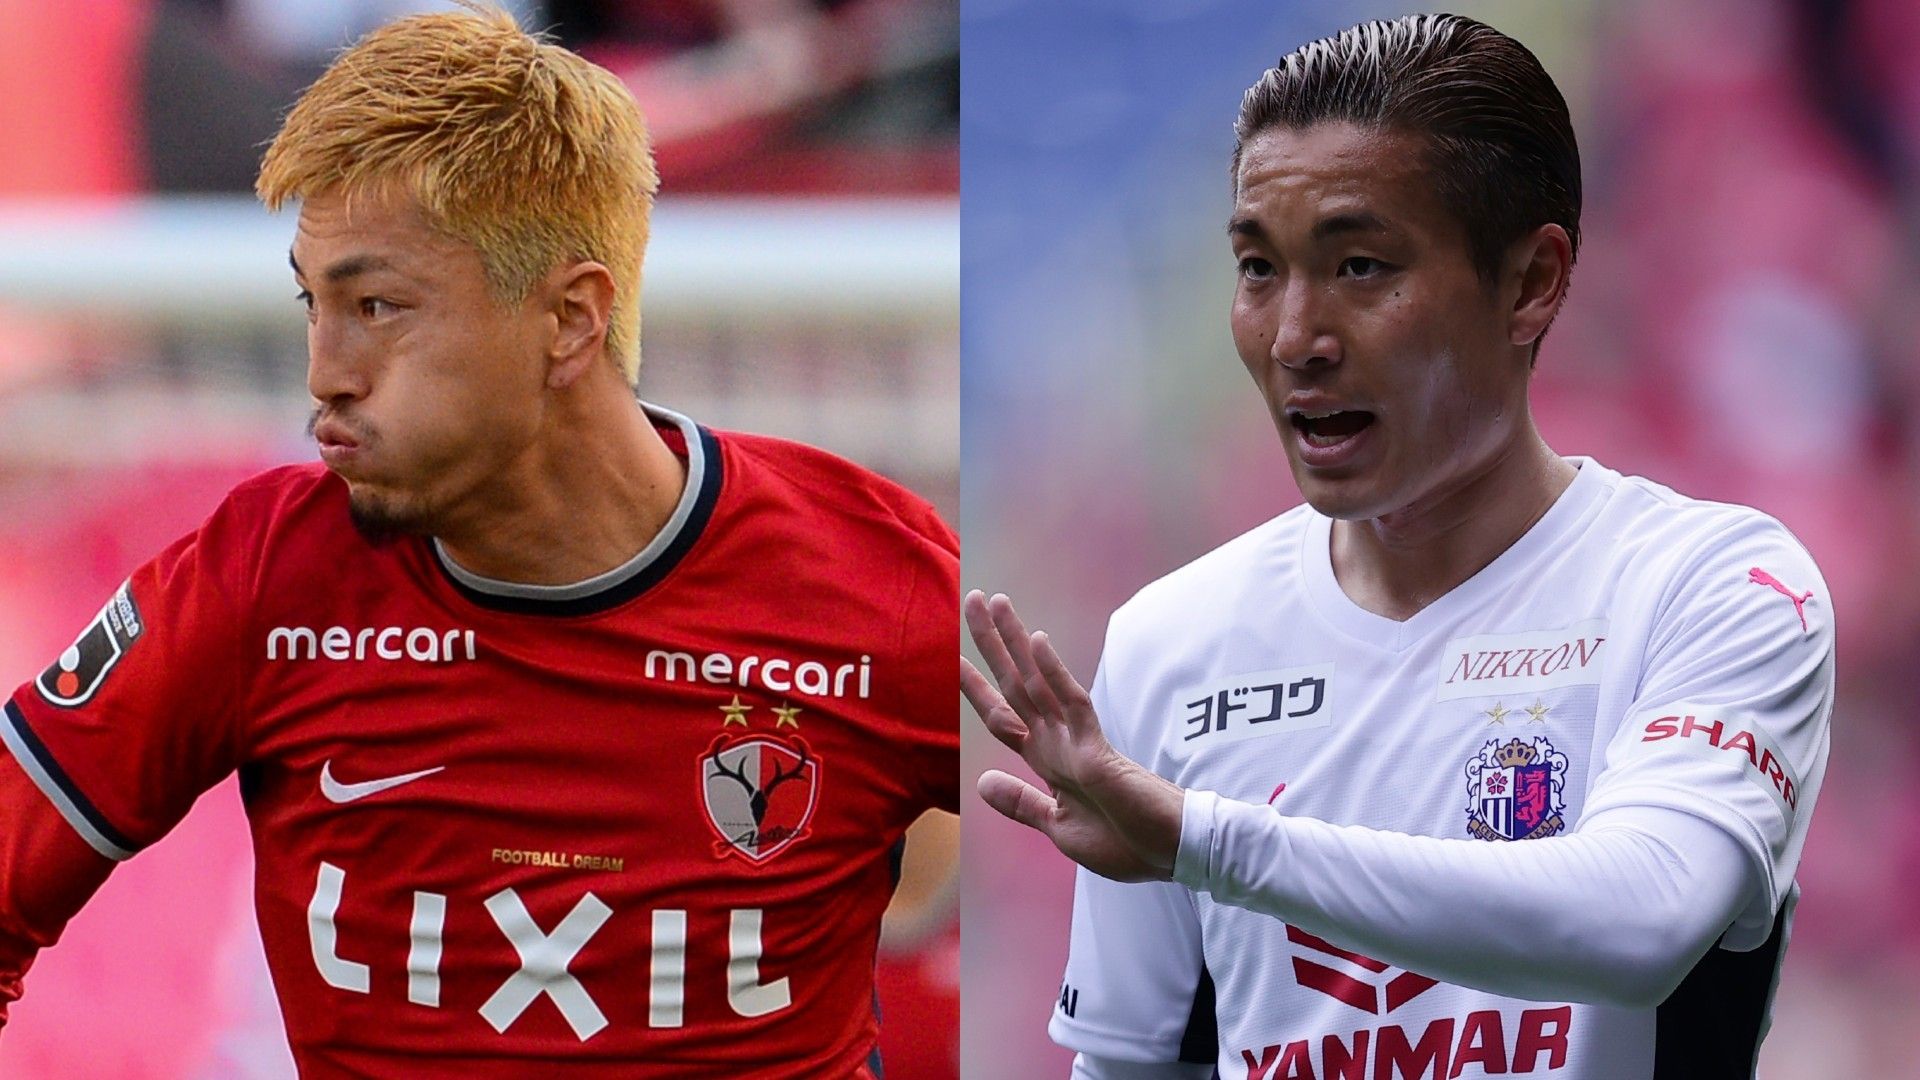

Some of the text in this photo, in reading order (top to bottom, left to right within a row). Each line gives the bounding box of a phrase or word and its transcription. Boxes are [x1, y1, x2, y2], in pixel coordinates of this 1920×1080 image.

[267, 626, 476, 662] mercari
[1446, 638, 1605, 684] NIKKON
[645, 650, 871, 698] mercari
[1184, 677, 1326, 742] ヨドコウ
[1641, 715, 1796, 812] SHARP
[491, 848, 624, 871] FOOTBALL DREAM
[307, 861, 792, 1042] LIXIL
[1241, 1006, 1572, 1080] YANMAR
